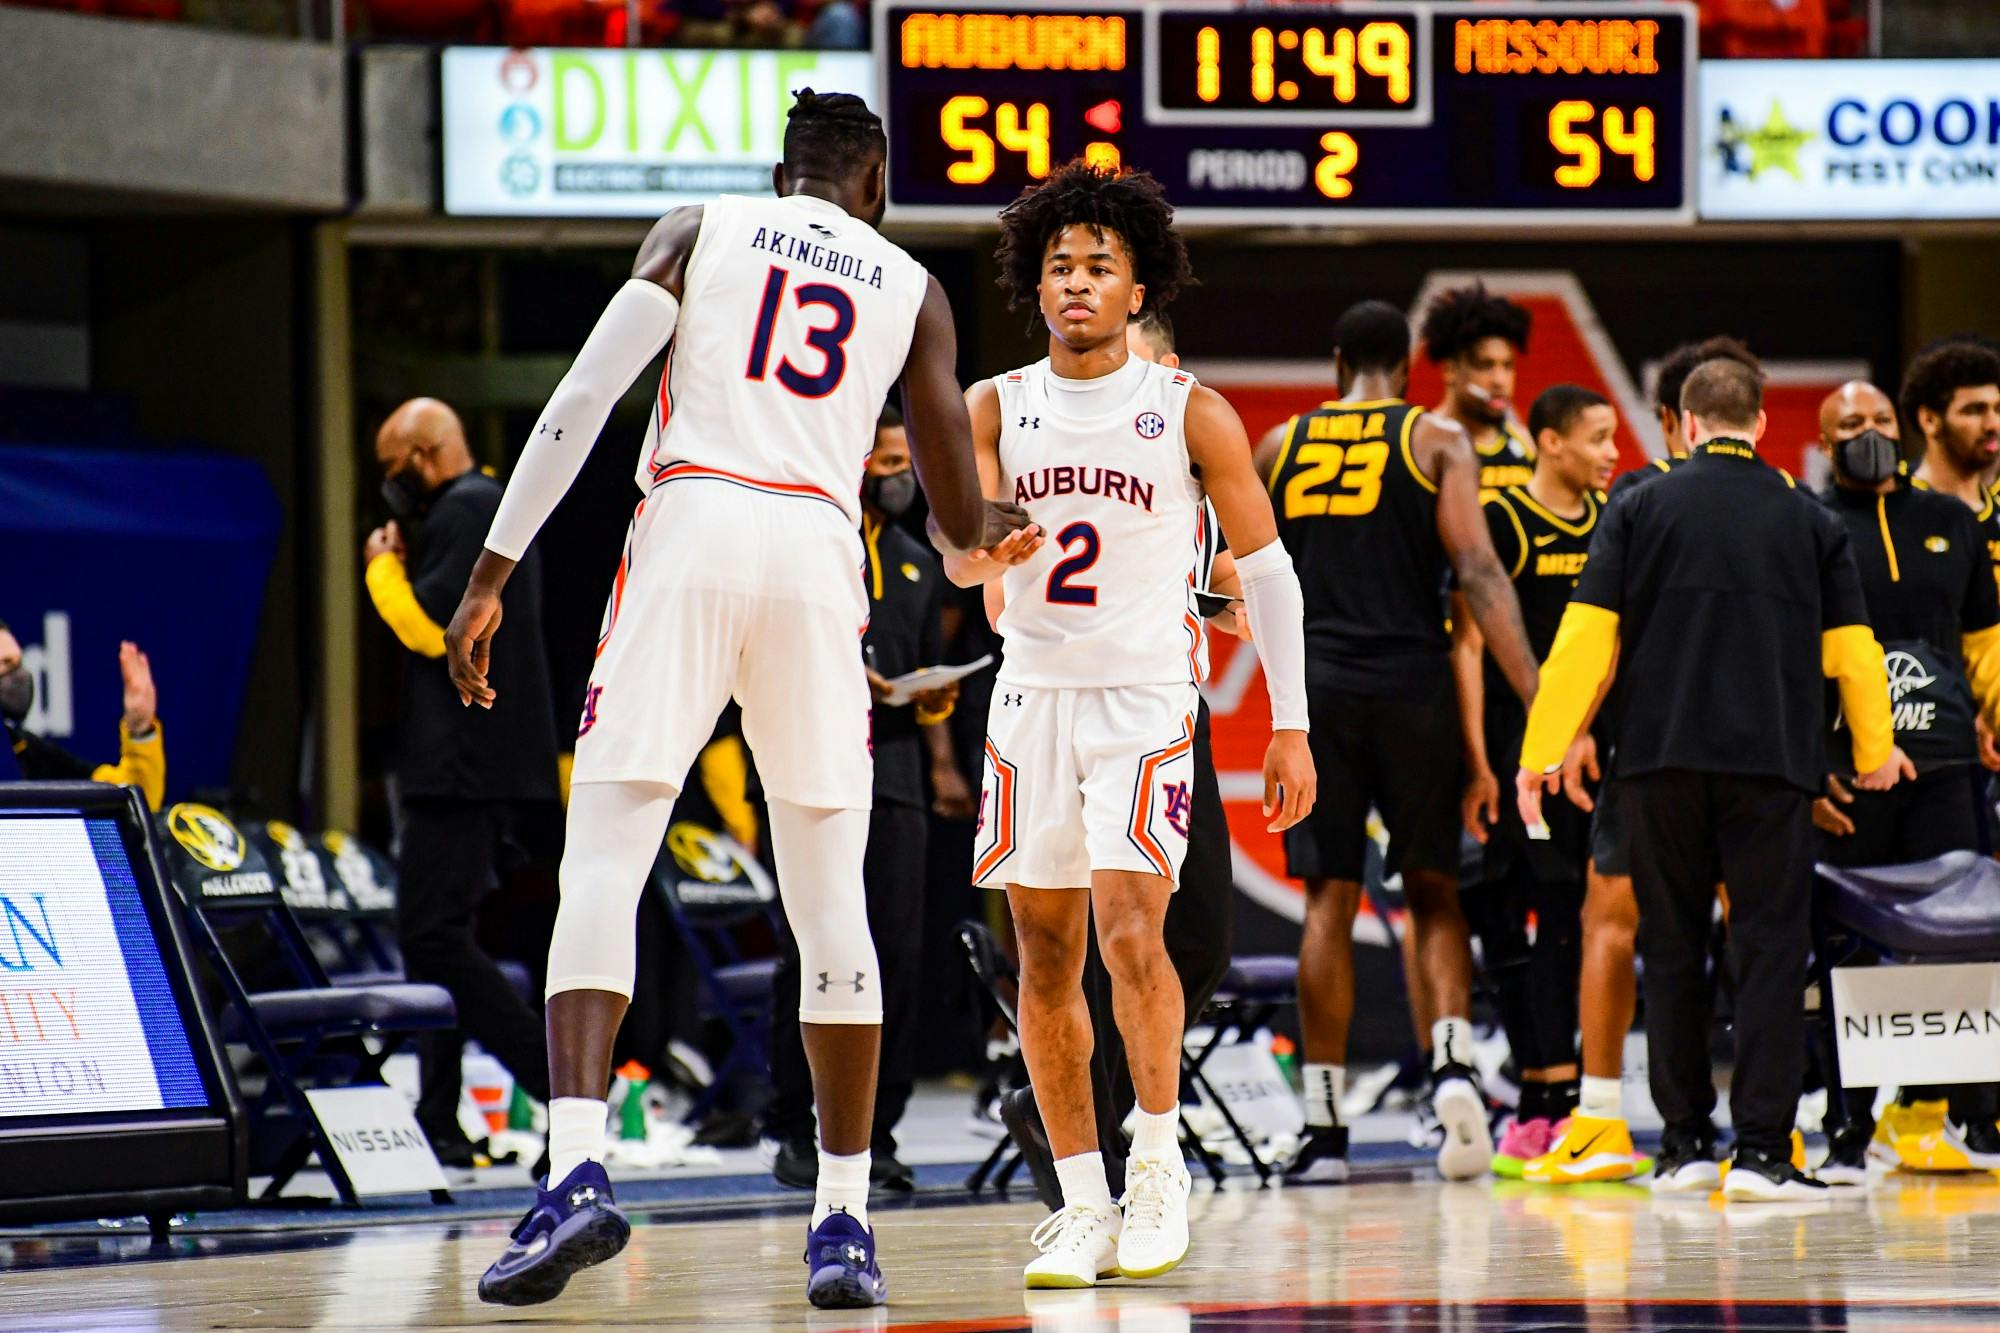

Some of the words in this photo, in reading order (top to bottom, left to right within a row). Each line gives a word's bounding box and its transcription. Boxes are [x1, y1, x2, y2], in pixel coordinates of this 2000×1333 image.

[901, 13, 1126, 70] AUBURN
[1197, 21, 1410, 103] 11:49
[1454, 19, 1660, 74] MISSOURI
[940, 95, 1050, 184] 54
[1188, 150, 1305, 190] PERIOD
[1315, 131, 1358, 198] 2
[1548, 100, 1655, 188] 54
[1827, 160, 1907, 182] PEST
[752, 227, 883, 290] AKINGBOLA
[745, 264, 857, 399] 13
[1015, 466, 1154, 513] AUBURN
[1284, 441, 1389, 520] 23
[1045, 520, 1101, 607] 2
[1844, 1009, 2000, 1038] NISSAN
[332, 1127, 424, 1152] NISSAN
